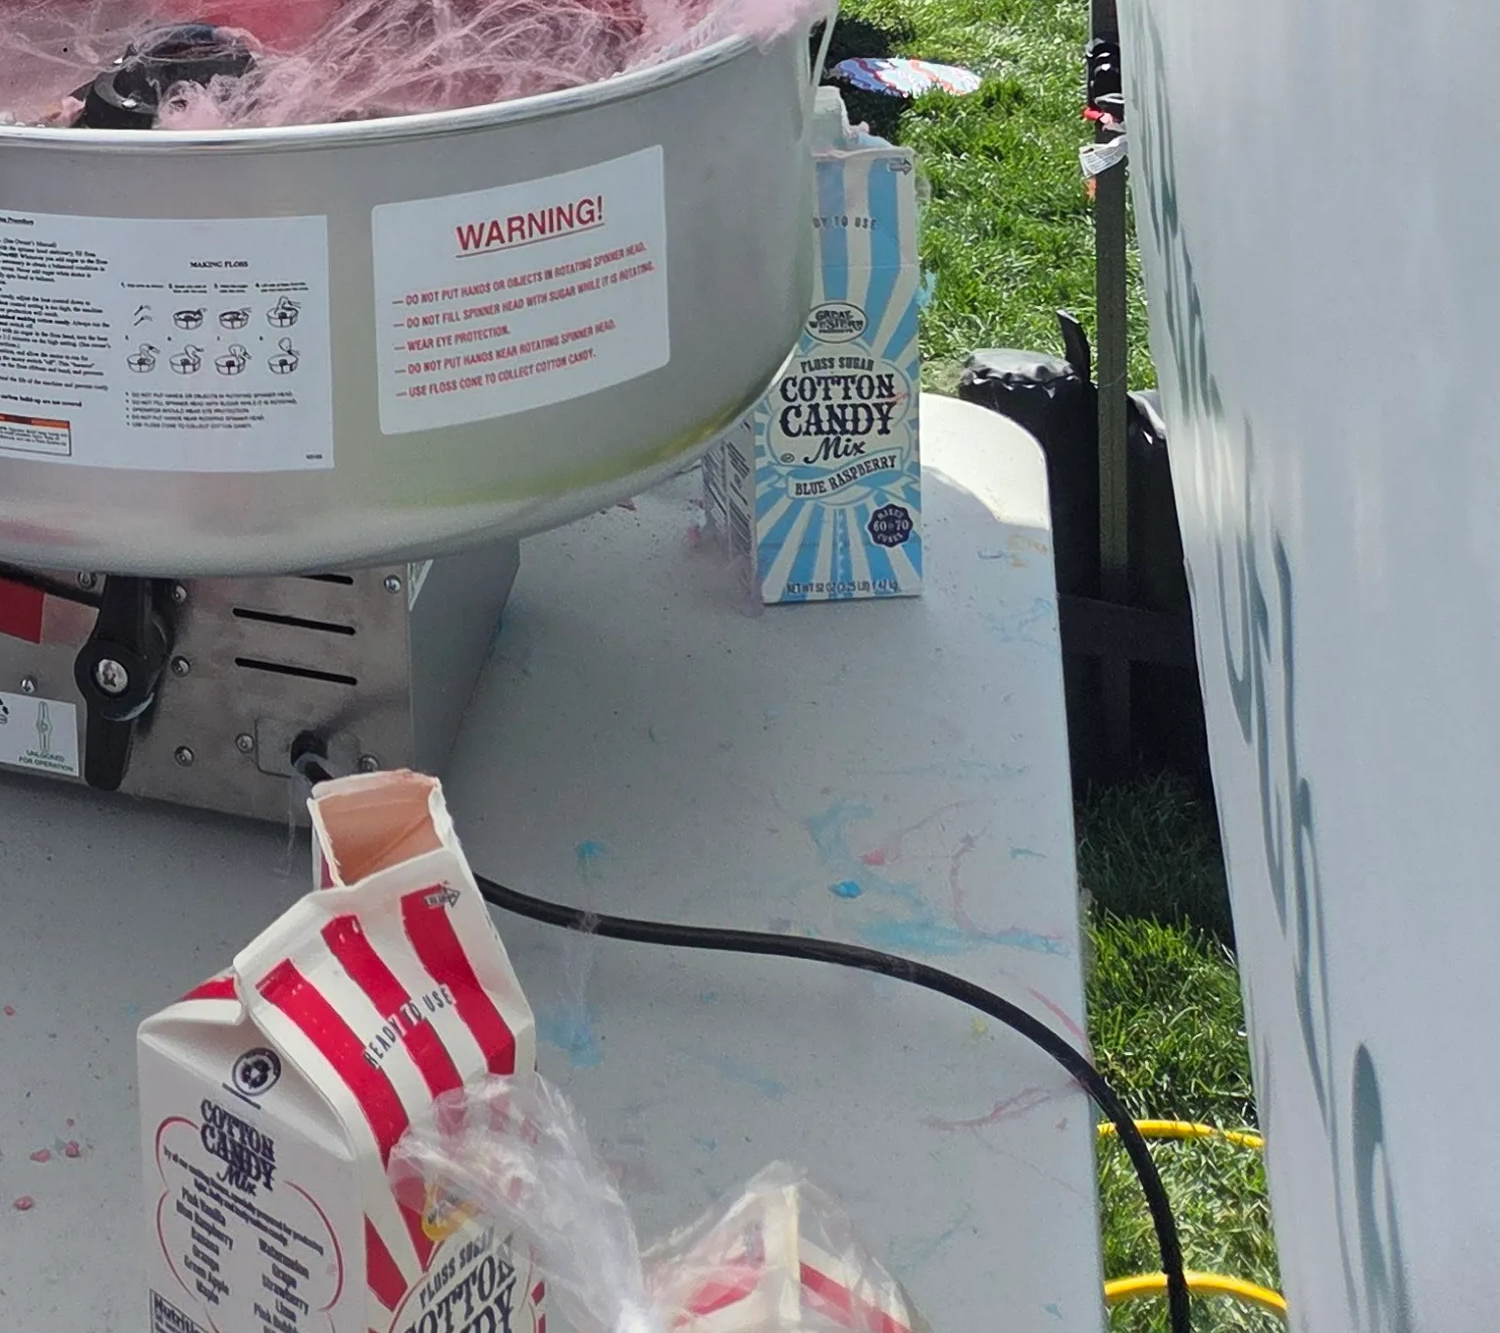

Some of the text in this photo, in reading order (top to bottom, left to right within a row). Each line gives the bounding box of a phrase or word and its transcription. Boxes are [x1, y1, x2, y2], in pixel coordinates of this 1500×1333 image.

[456, 195, 604, 252] WARNING!
[834, 215, 849, 228] TO
[854, 216, 877, 231] USE
[405, 241, 647, 306] DO NOT PUT HANDS OR OBJECTS IN ROTATING SPINNER HEAD.
[406, 260, 655, 329] DO NOT FILL SPINNER HEAD WITH SUGAR WHILE IT IS ROTATING.
[407, 325, 510, 351] WEAR EYE PROTECTION.
[408, 319, 616, 375] DO NOT PUT HANDS NEAR ROTATING SPINNER HEAD.
[409, 348, 596, 398] USE FLOSS CONE TO COLLECT COTTON CANDY.
[800, 356, 875, 374] FLOSS SUGAR
[779, 373, 897, 403] COTTON
[779, 401, 897, 438] CANDY
[803, 436, 866, 465] Mix
[795, 455, 897, 496] BLUE RASPBERRY
[873, 520, 887, 532] 60
[895, 519, 910, 531] 70
[364, 987, 454, 1069] READY TO USE
[200, 1099, 276, 1163] COTTON
[200, 1122, 277, 1193] CANDY
[216, 1162, 257, 1197] Mix
[261, 1272, 309, 1316] Strawberry
[419, 1256, 456, 1310] FLOSS
